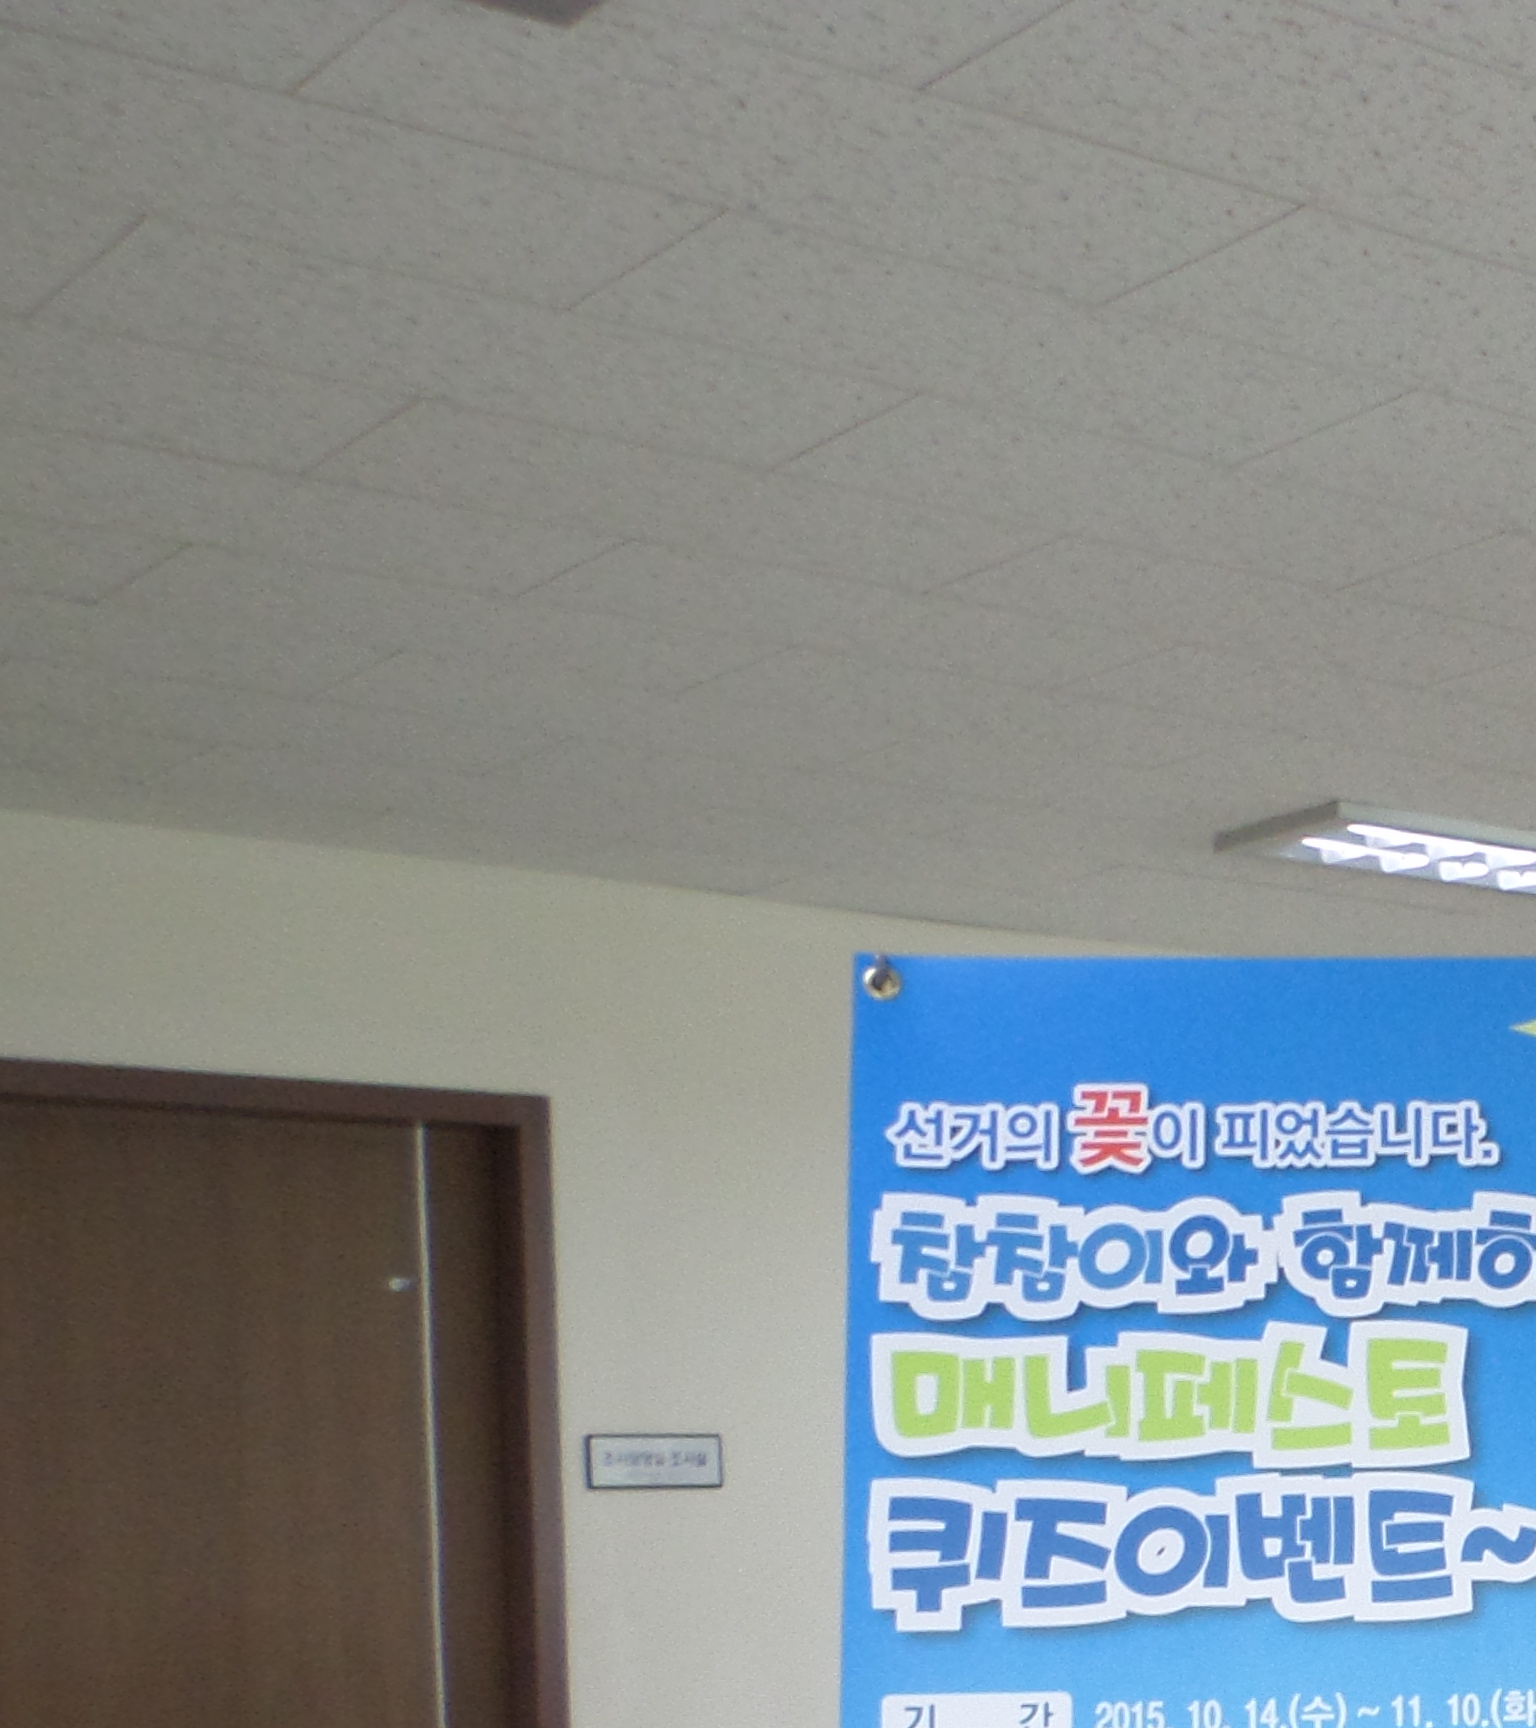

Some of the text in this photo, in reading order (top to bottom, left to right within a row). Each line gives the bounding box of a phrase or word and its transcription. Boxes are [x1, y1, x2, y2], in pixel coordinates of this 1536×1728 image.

[889, 1082, 1500, 1173] 선거의 꽃이 피었습니다.
[880, 1200, 1270, 1313] 참참이와
[881, 1331, 1459, 1457] 매니페스토
[1391, 1693, 1433, 1728] 11.
